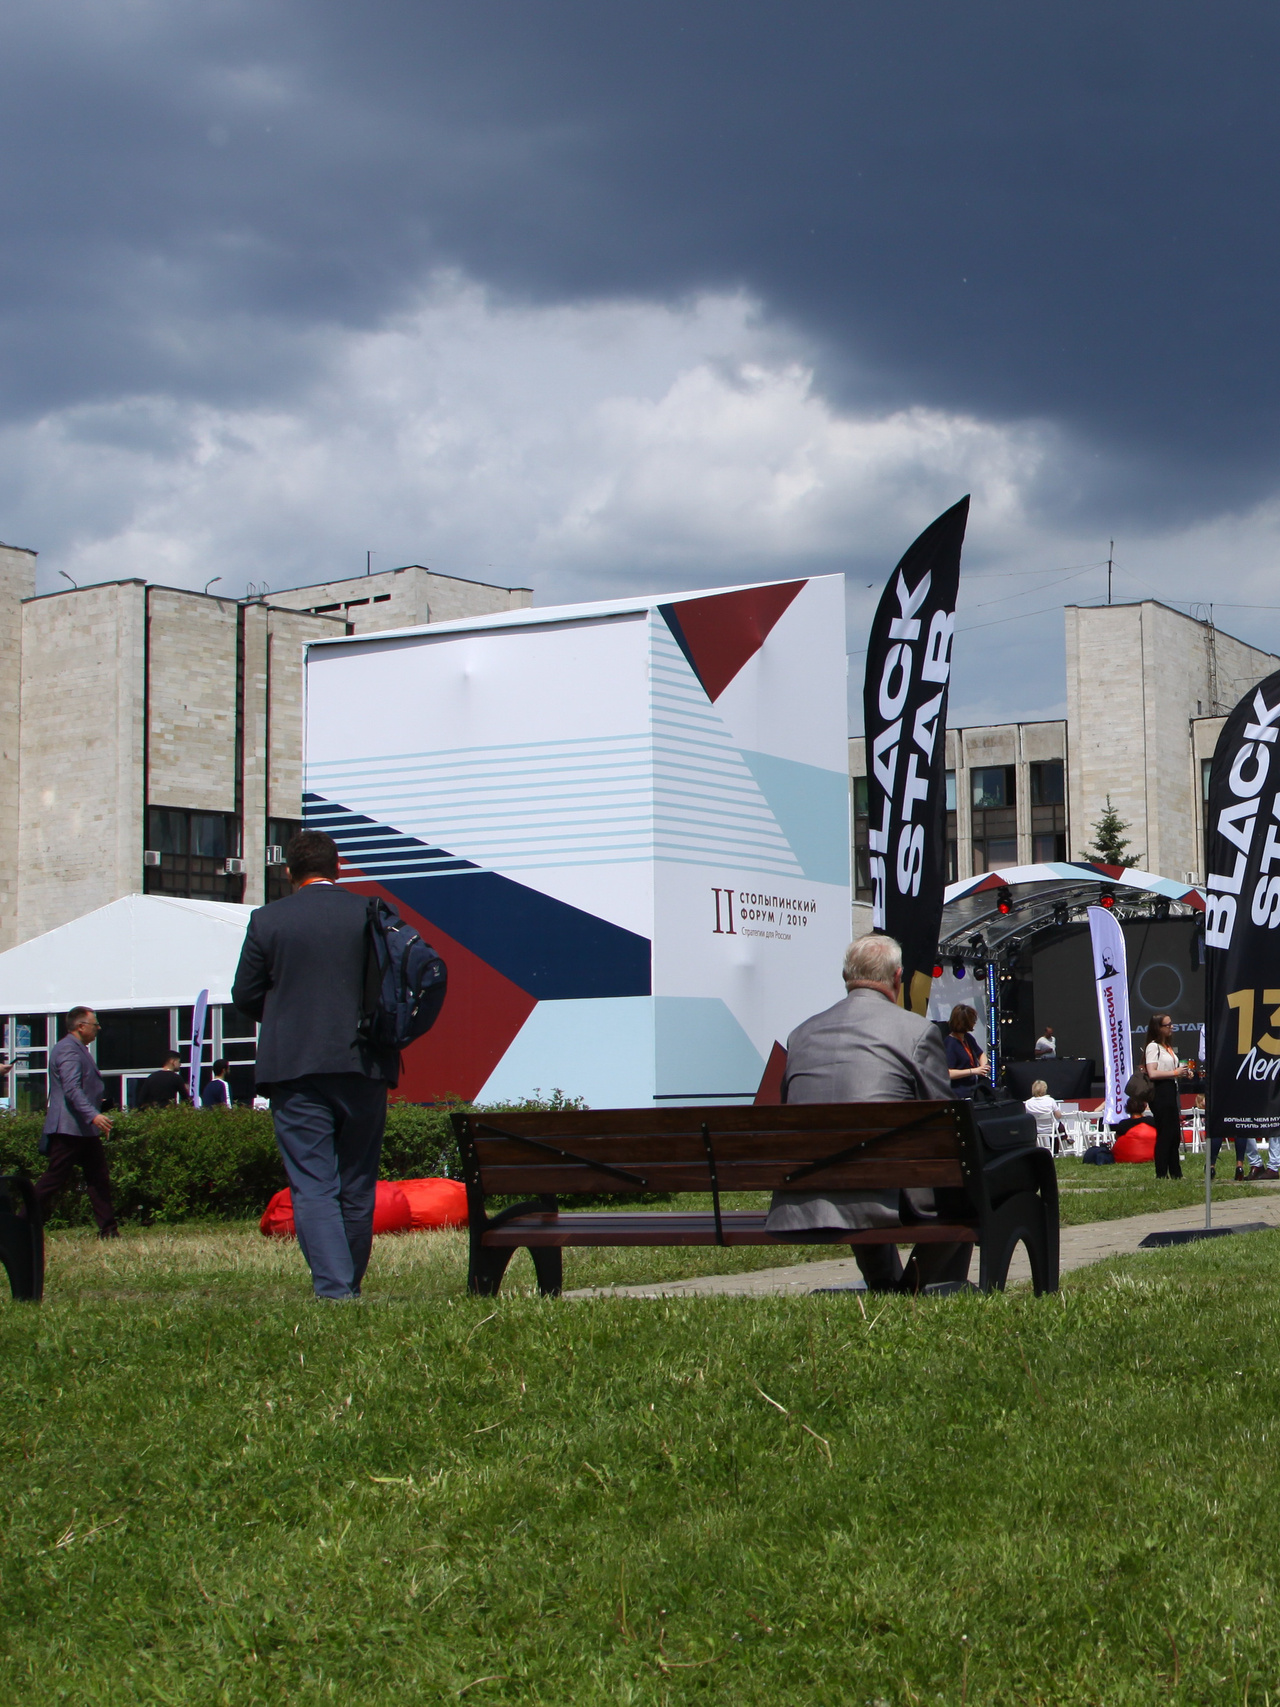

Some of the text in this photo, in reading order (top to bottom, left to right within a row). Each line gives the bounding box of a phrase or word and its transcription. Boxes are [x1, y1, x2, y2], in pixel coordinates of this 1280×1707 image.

[869, 567, 932, 930] BLACK
[896, 608, 957, 898] STAR
[710, 888, 738, 935] II
[739, 891, 817, 914] СТОЛЫПИНСКИЙ
[740, 908, 775, 923] ФОРУМ
[787, 914, 808, 927] 2019
[741, 926, 792, 941] Стратегии для России
[1104, 986, 1123, 1115] СТОЛЫПИНСКИЙ
[1117, 1020, 1126, 1076] ФОРУМ
